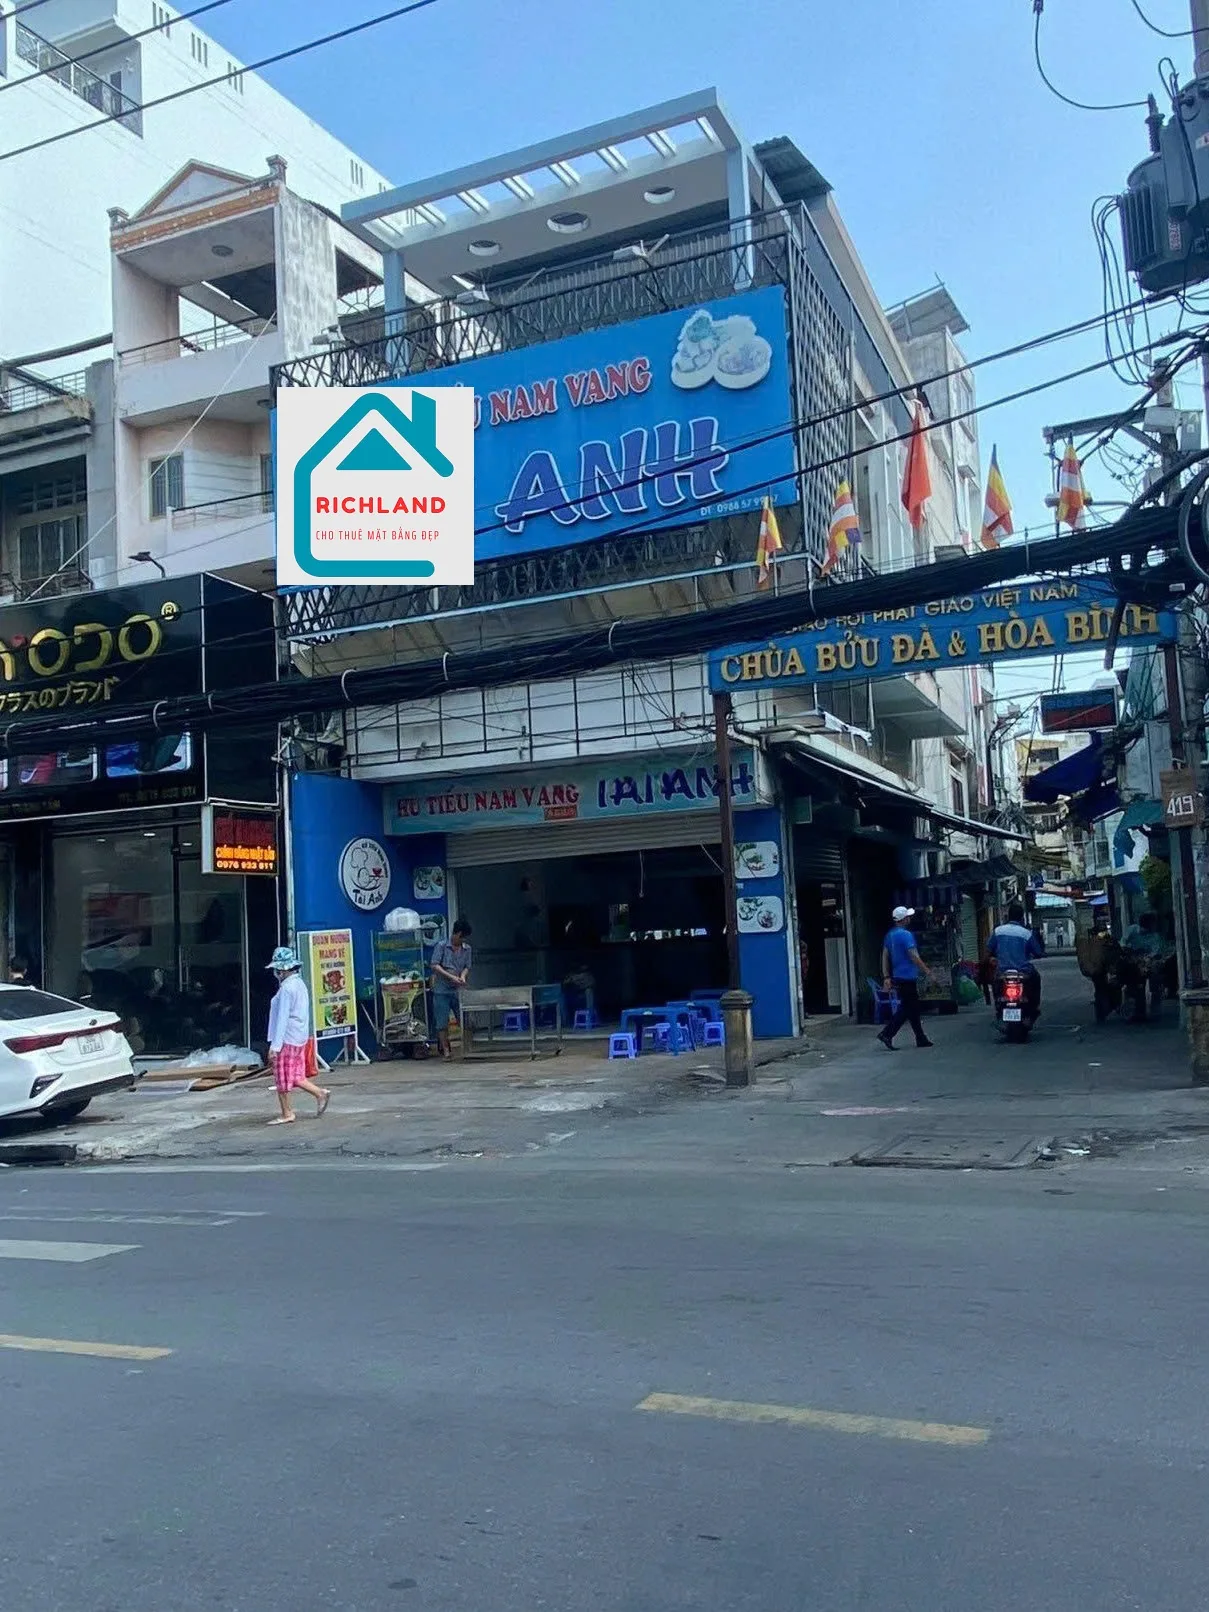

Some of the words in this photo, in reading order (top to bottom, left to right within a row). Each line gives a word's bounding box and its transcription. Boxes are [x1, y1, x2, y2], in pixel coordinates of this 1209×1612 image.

[488, 378, 558, 425] NAM
[563, 357, 653, 408] VANG
[495, 416, 730, 534] ANH
[982, 587, 1022, 610] VIỆT
[1029, 583, 1078, 602] NAM
[720, 641, 806, 683] CHÙA
[816, 629, 880, 673] BỬU
[948, 630, 967, 657] &
[978, 610, 1055, 653] HÒA
[473, 785, 518, 812] NAM
[521, 783, 580, 807] VANG
[661, 763, 754, 801] ANH
[1167, 795, 1194, 816] 419
